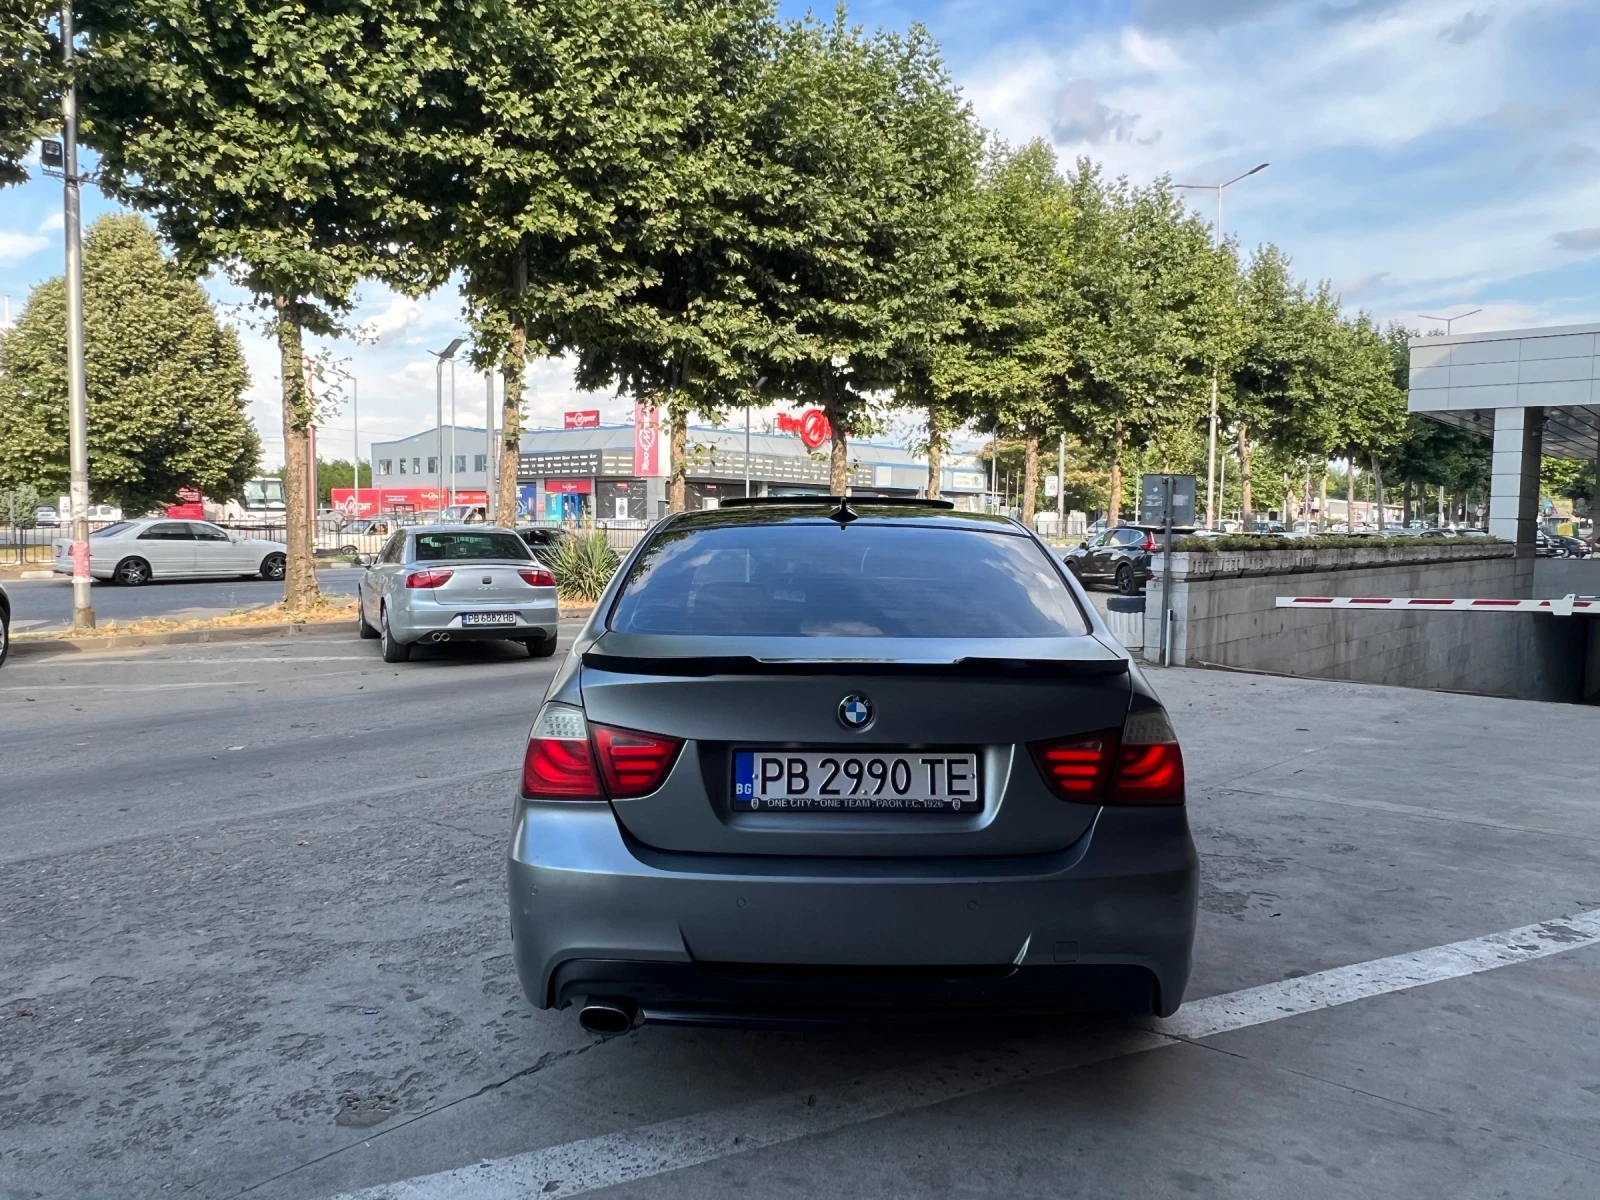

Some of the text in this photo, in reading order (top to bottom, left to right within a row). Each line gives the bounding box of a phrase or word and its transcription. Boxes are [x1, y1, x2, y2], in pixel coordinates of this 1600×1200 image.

[760, 757, 971, 796] PB 2990 TE
[736, 783, 752, 795] BG
[767, 799, 788, 808] ONE
[790, 799, 813, 808] CITY
[820, 799, 841, 808] ONE
[876, 799, 903, 808] PAOK
